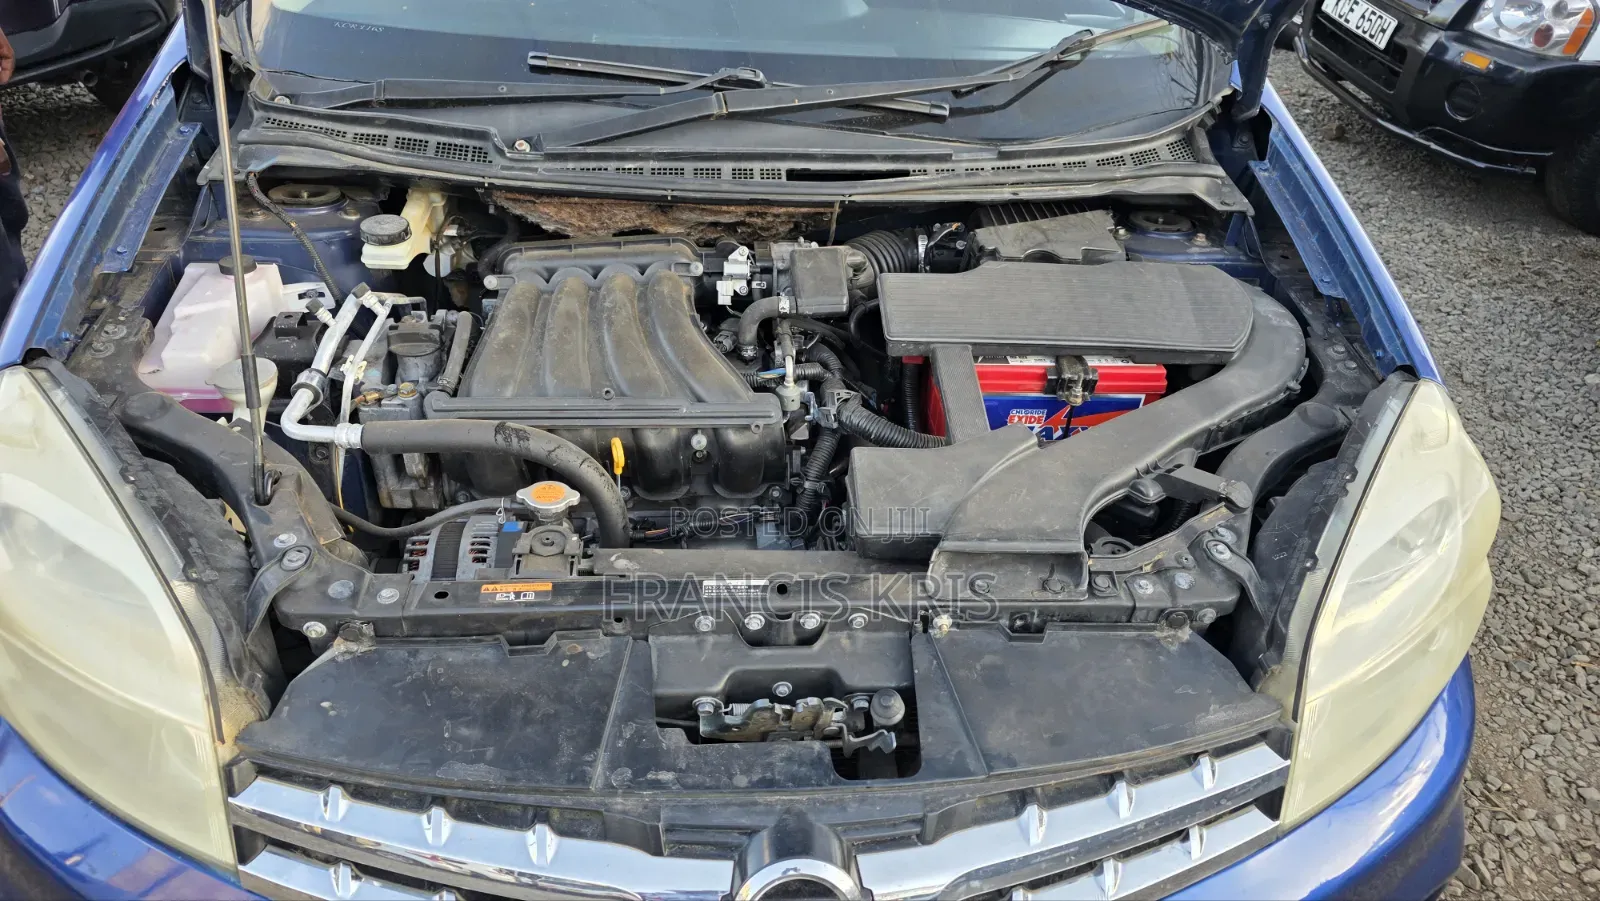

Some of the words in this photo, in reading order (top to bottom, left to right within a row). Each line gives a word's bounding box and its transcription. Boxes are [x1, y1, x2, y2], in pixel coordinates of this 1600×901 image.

[1331, 0, 1360, 24] KCE
[1355, 7, 1392, 44] 650H
[1008, 415, 1045, 424] EXIDE
